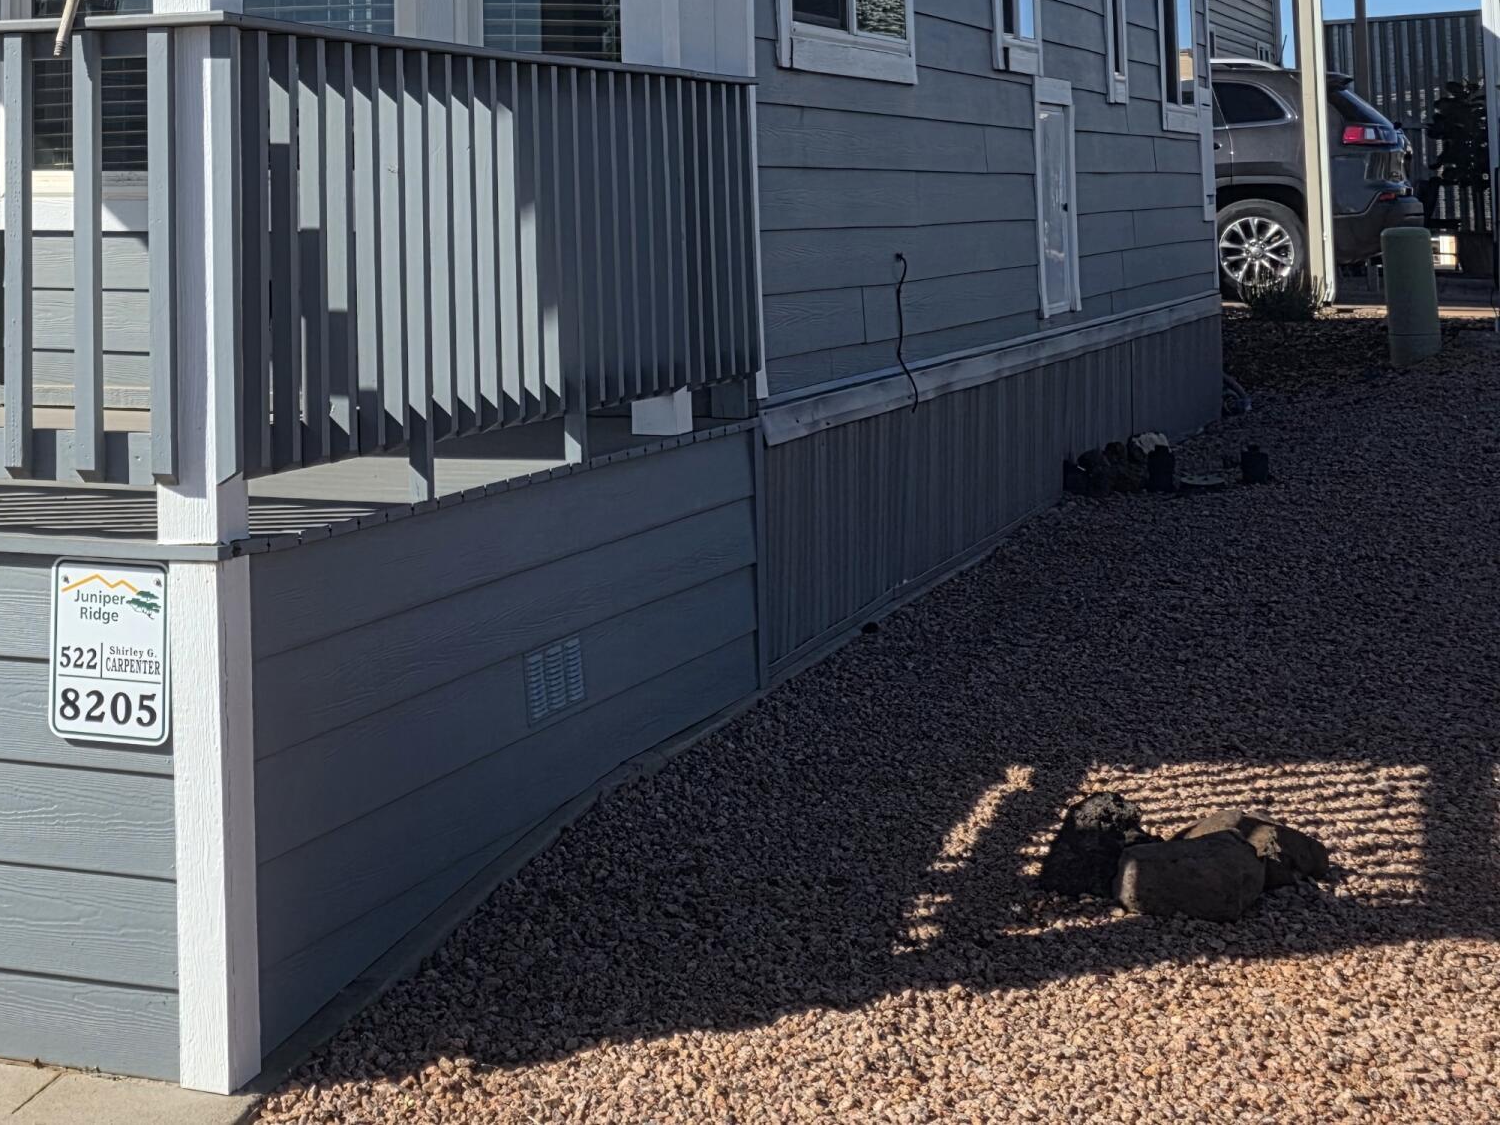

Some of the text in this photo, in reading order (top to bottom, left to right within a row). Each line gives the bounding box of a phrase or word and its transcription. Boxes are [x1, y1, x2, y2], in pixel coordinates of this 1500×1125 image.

[74, 589, 126, 607] Juniper
[80, 606, 119, 624] Ridge
[59, 645, 98, 670] 522
[109, 645, 158, 658] Shirley G.
[105, 657, 161, 676] CARPENTER
[59, 687, 158, 728] 8205
